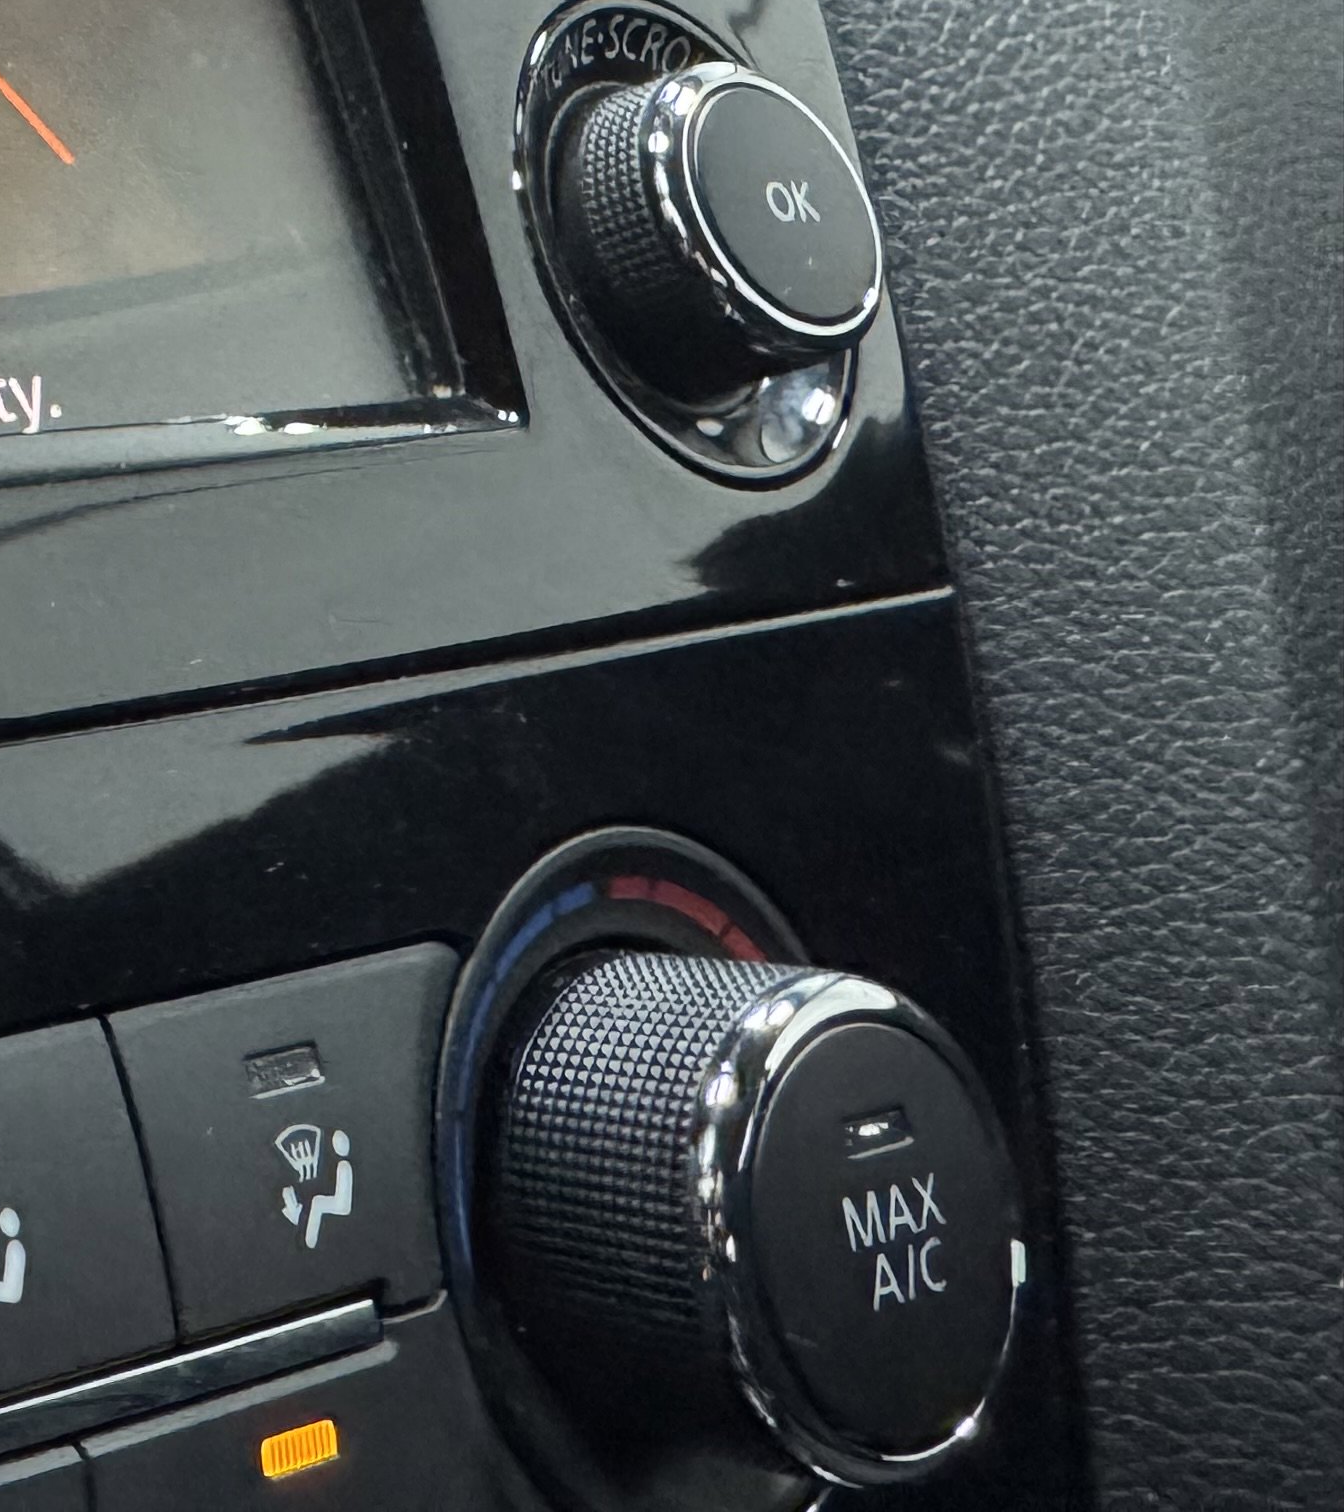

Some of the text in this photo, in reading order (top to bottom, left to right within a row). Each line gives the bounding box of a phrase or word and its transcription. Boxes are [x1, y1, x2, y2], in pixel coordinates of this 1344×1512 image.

[765, 179, 821, 224] OK
[841, 1173, 947, 1252] MAX
[872, 1238, 948, 1311] A/C
